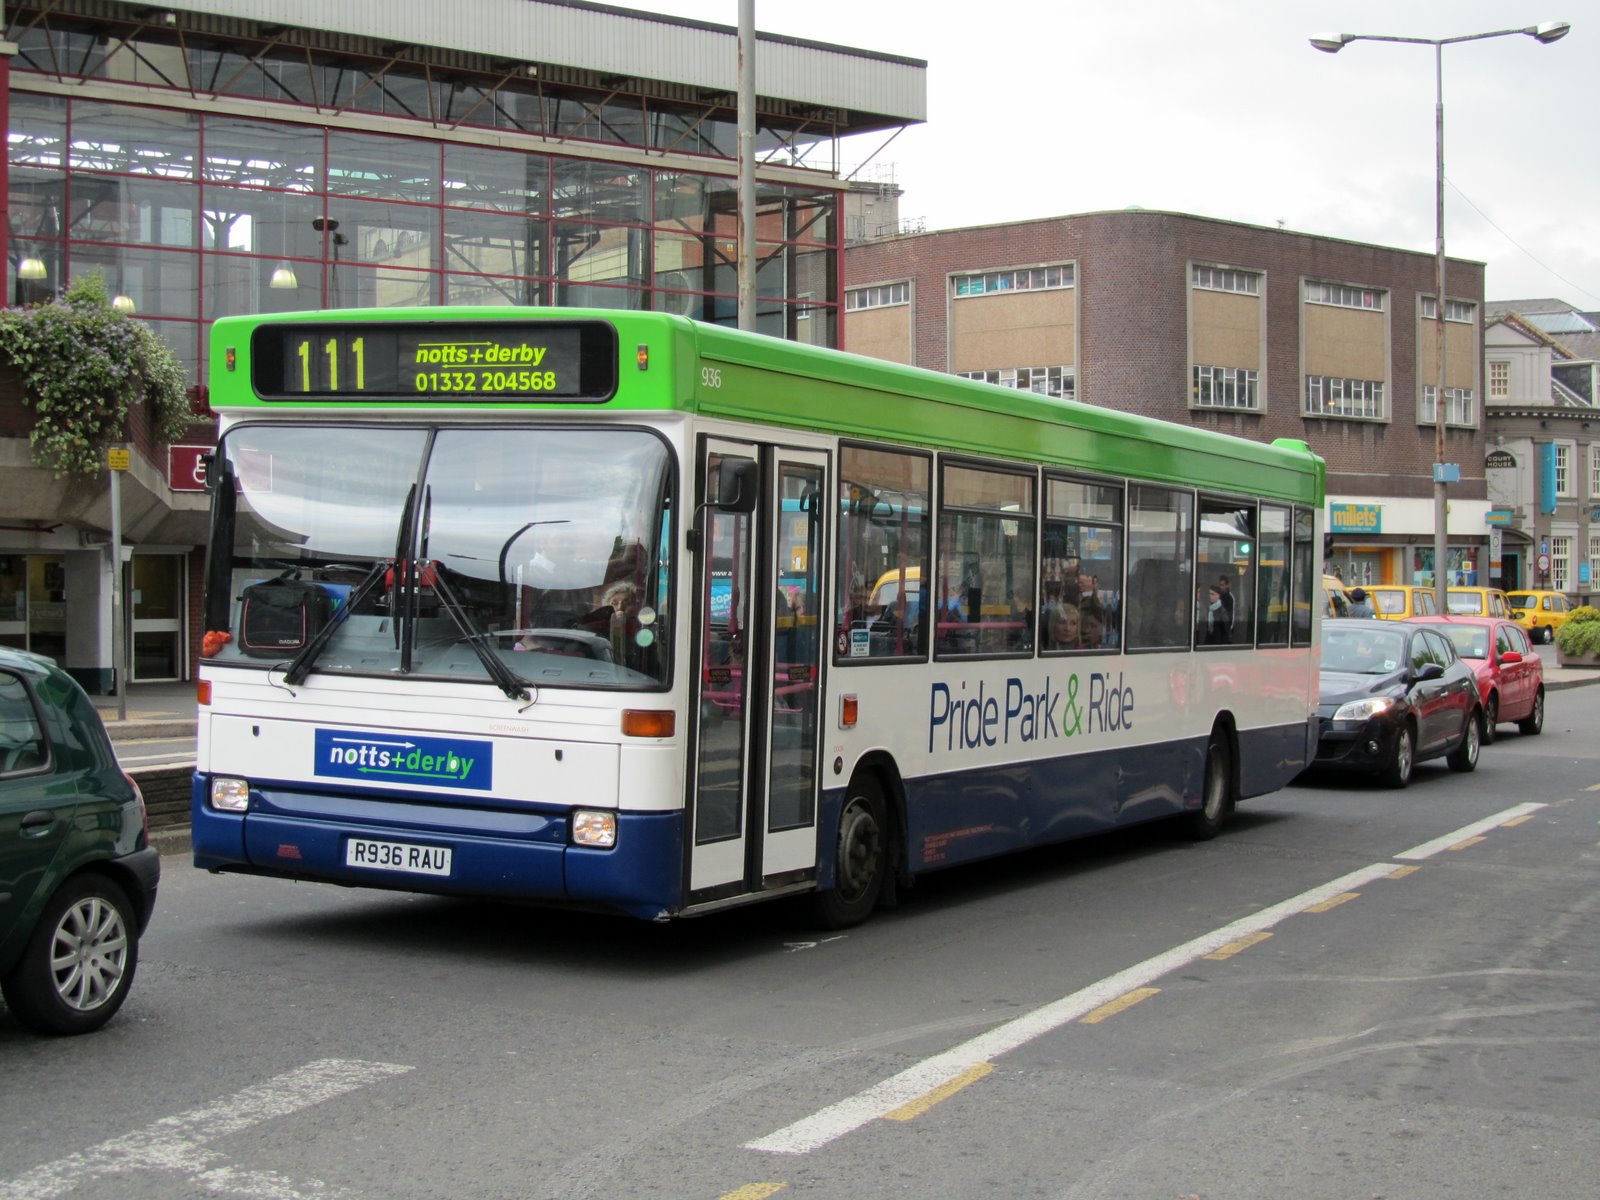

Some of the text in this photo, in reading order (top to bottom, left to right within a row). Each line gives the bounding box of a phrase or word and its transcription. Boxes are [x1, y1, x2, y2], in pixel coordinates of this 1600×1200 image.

[415, 343, 546, 366] notts+derby
[415, 371, 556, 392] 01332 204568
[701, 366, 722, 389] 936
[1333, 505, 1377, 527] millets
[929, 671, 1134, 753] Pride Park & Ride
[330, 744, 475, 780] notts+derby
[354, 842, 446, 870] R936 RAU
